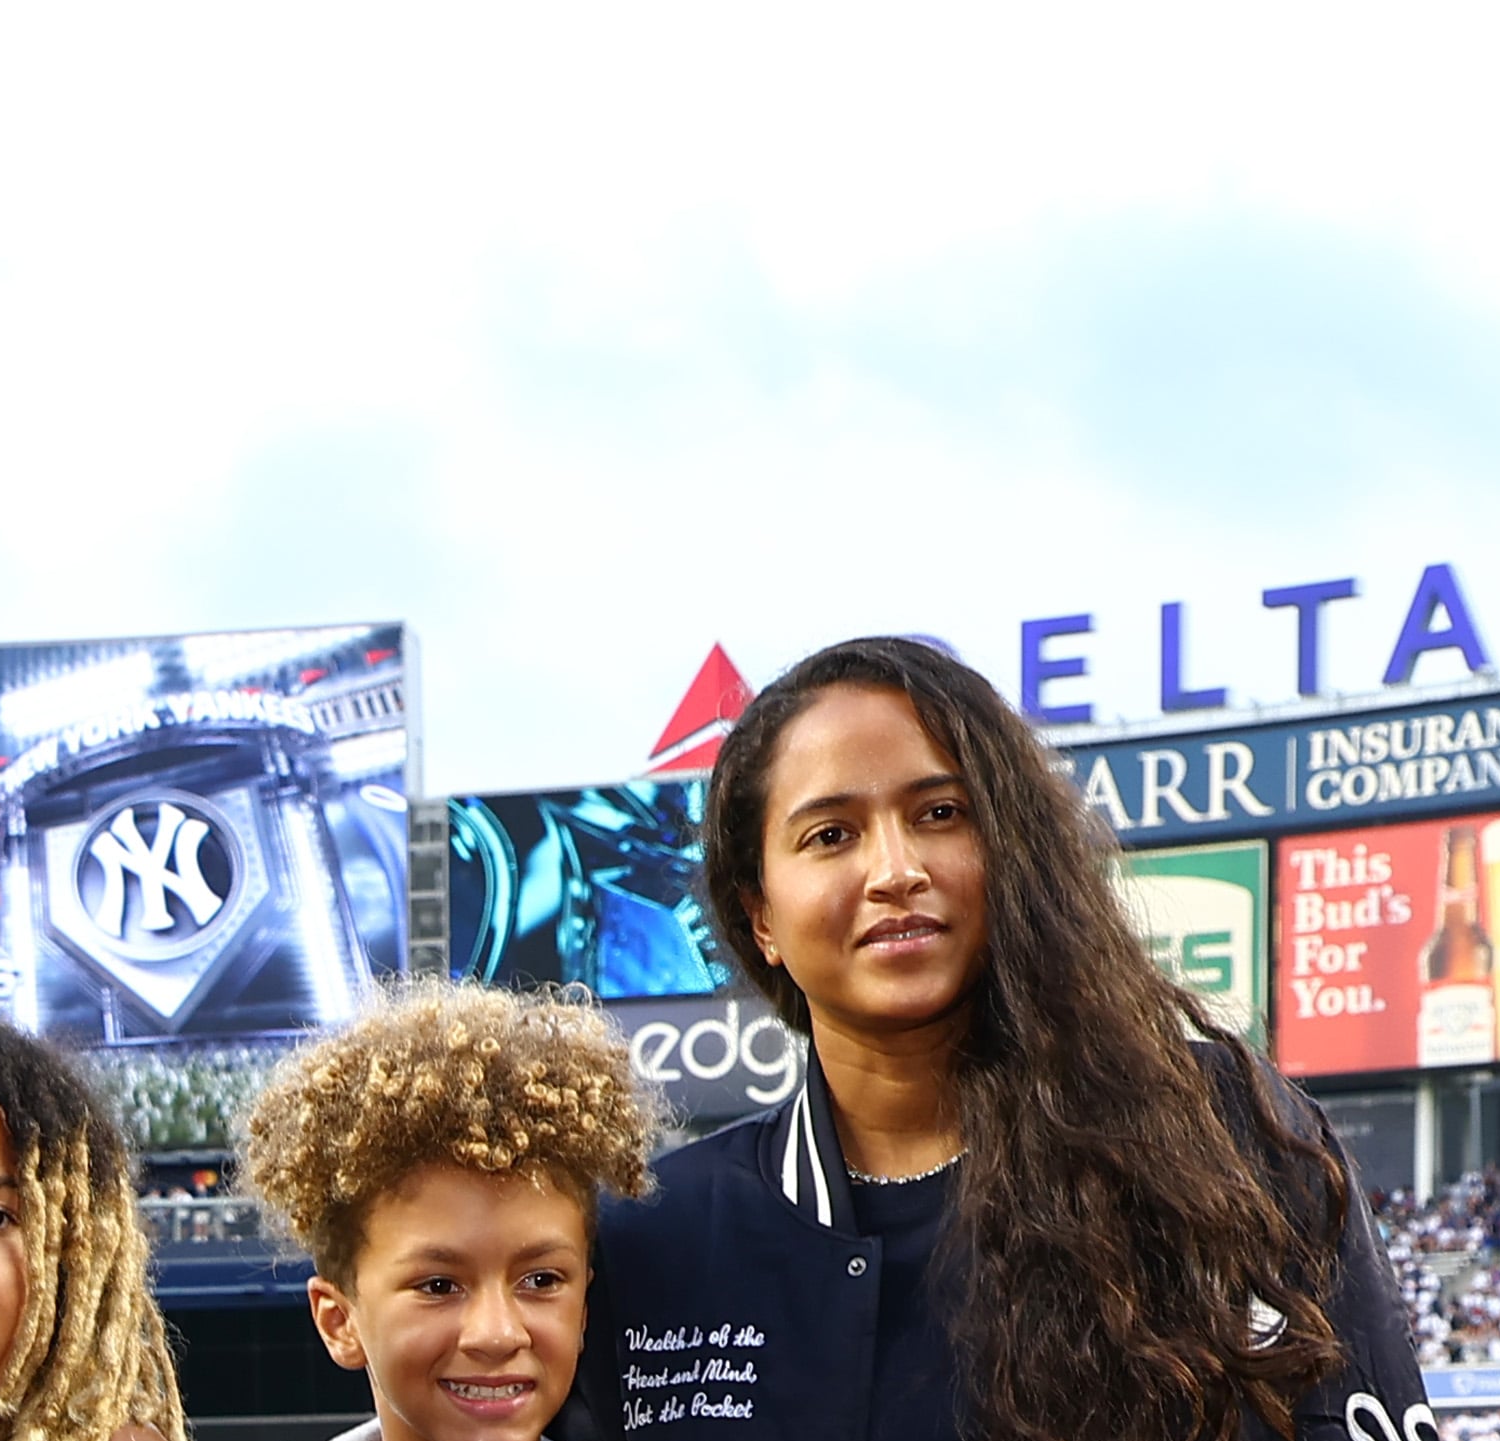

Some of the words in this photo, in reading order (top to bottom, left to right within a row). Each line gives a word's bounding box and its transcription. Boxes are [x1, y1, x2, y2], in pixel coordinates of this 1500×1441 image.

[902, 562, 1489, 725] ELTA
[1050, 742, 1276, 832] ARR
[1291, 844, 1393, 892] This
[1292, 884, 1413, 934] Bud's
[1291, 937, 1368, 978] For
[1292, 978, 1387, 1020] You.
[630, 1000, 809, 1105] edg
[625, 1323, 687, 1352] Wealth
[708, 1323, 732, 1348] of
[733, 1324, 766, 1348] the
[622, 1363, 669, 1392] Heart
[623, 1396, 654, 1432] Not
[658, 1395, 686, 1423] the
[690, 1391, 754, 1419] Pocket
